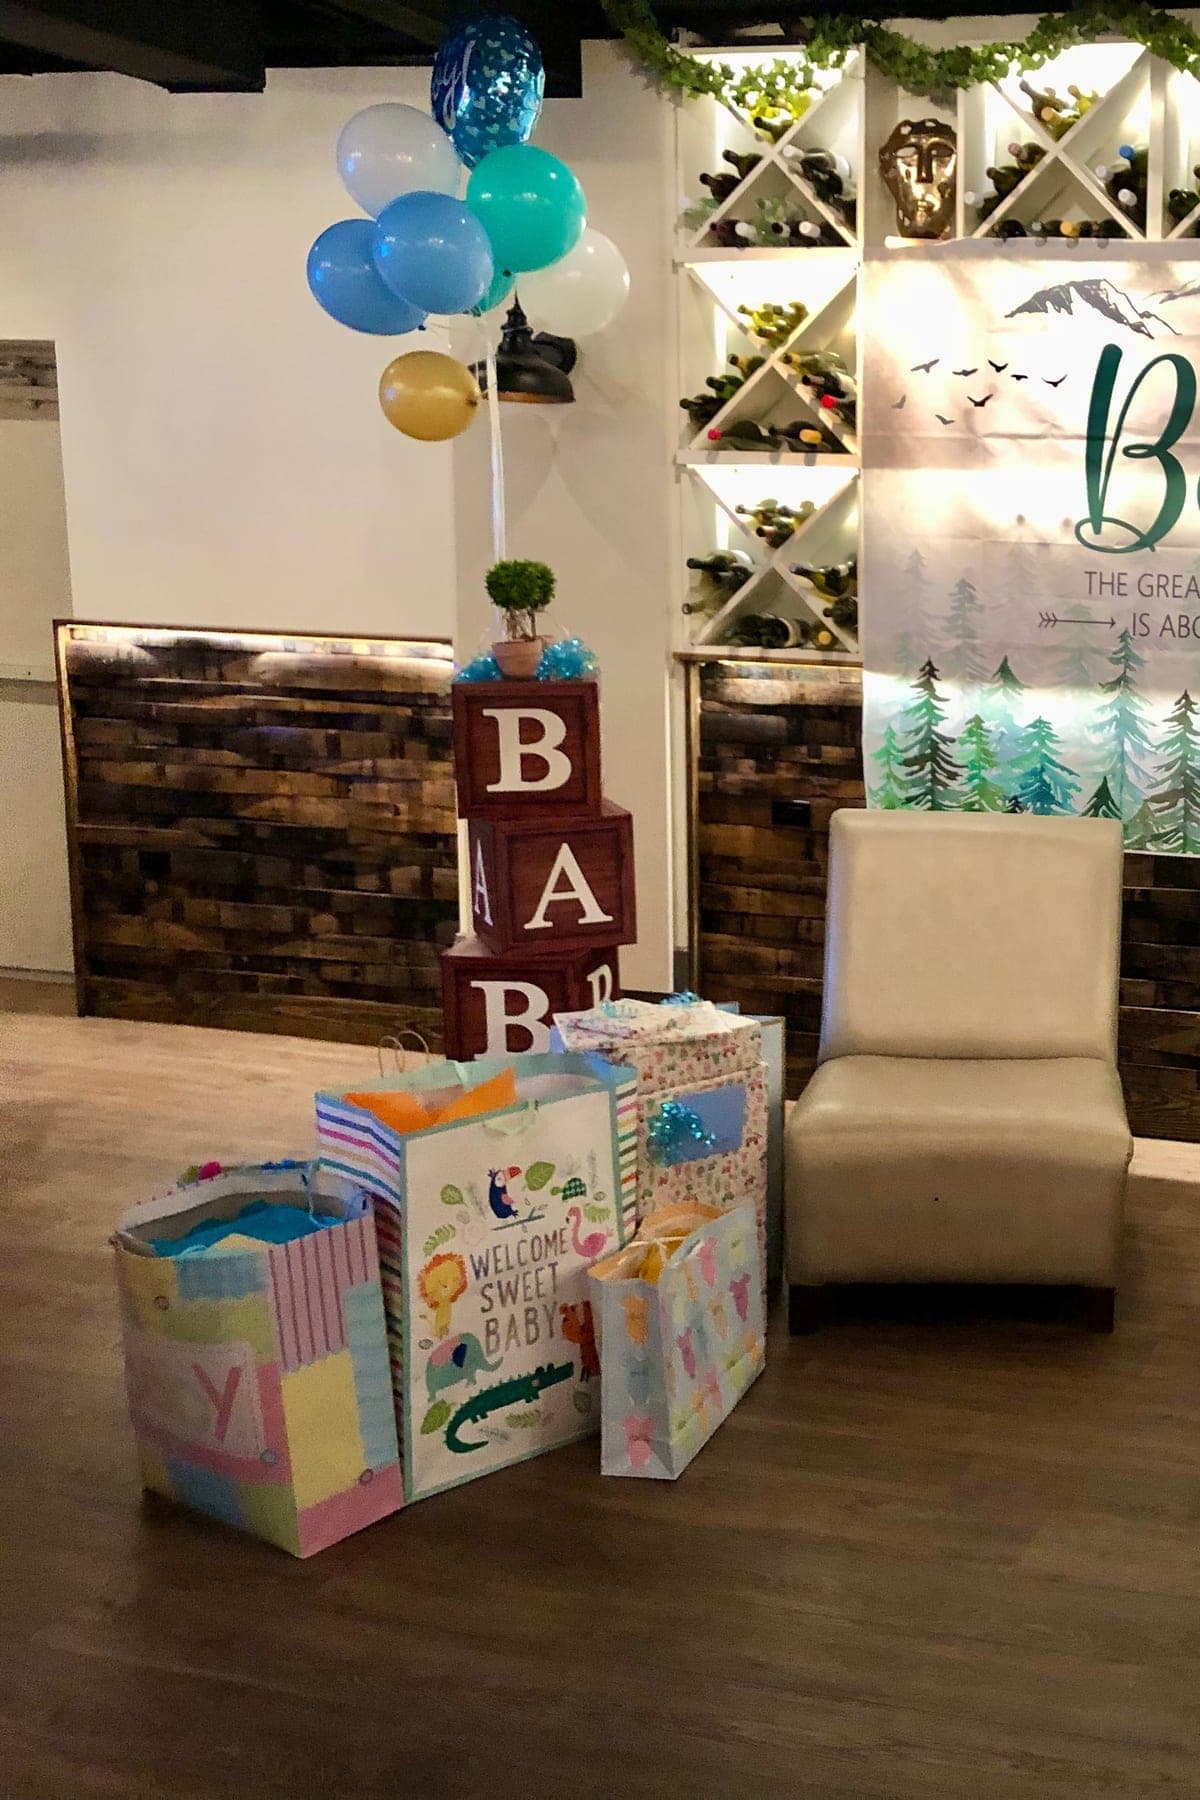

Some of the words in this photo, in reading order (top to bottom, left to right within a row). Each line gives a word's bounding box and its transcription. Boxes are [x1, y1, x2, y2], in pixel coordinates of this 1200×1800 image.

[1084, 571, 1129, 597] THE
[1131, 612, 1150, 637] IS
[482, 707, 572, 793] B
[473, 838, 494, 927] A
[523, 842, 614, 930] A
[470, 980, 551, 1057] B
[469, 1227, 569, 1281] WELCOME
[480, 1261, 559, 1314] SWEET
[485, 1301, 558, 1357] BABY
